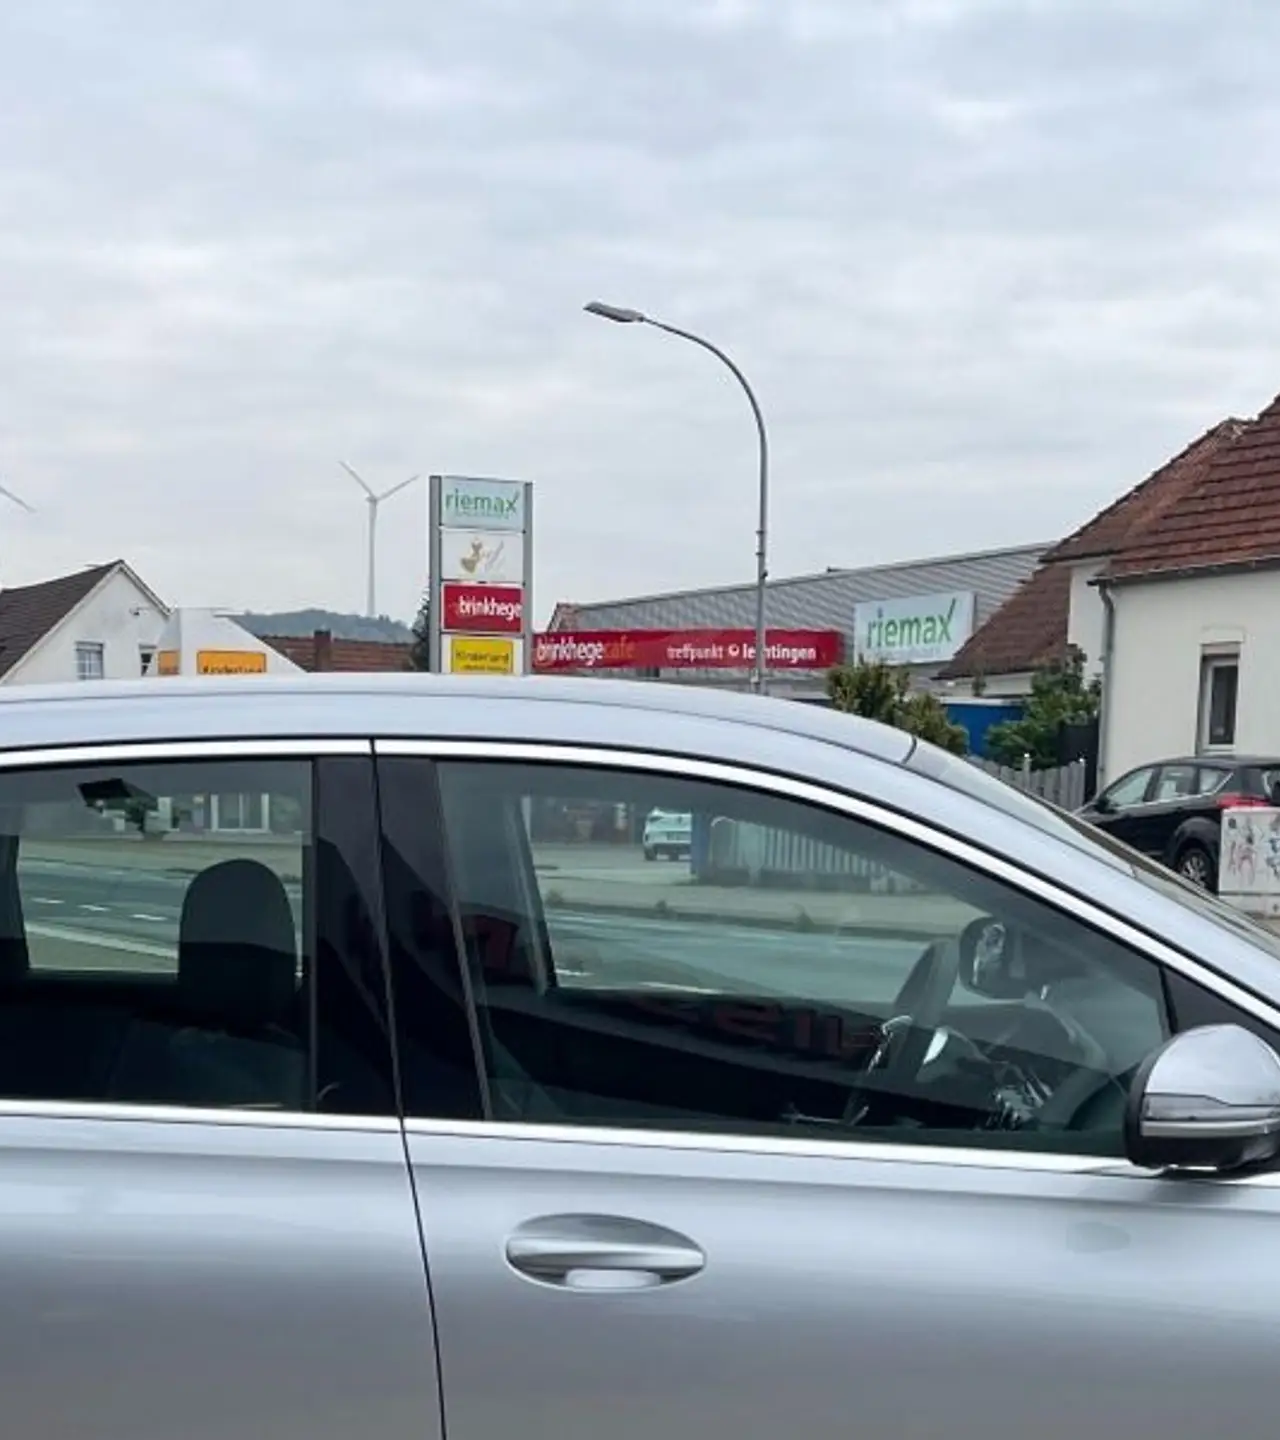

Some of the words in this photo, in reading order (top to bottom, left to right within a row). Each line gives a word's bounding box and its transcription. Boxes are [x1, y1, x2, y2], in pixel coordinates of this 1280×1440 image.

[445, 488, 519, 514] riemax
[459, 595, 523, 621] brinkhege
[867, 598, 956, 649] riemax
[743, 643, 817, 664] letingen
